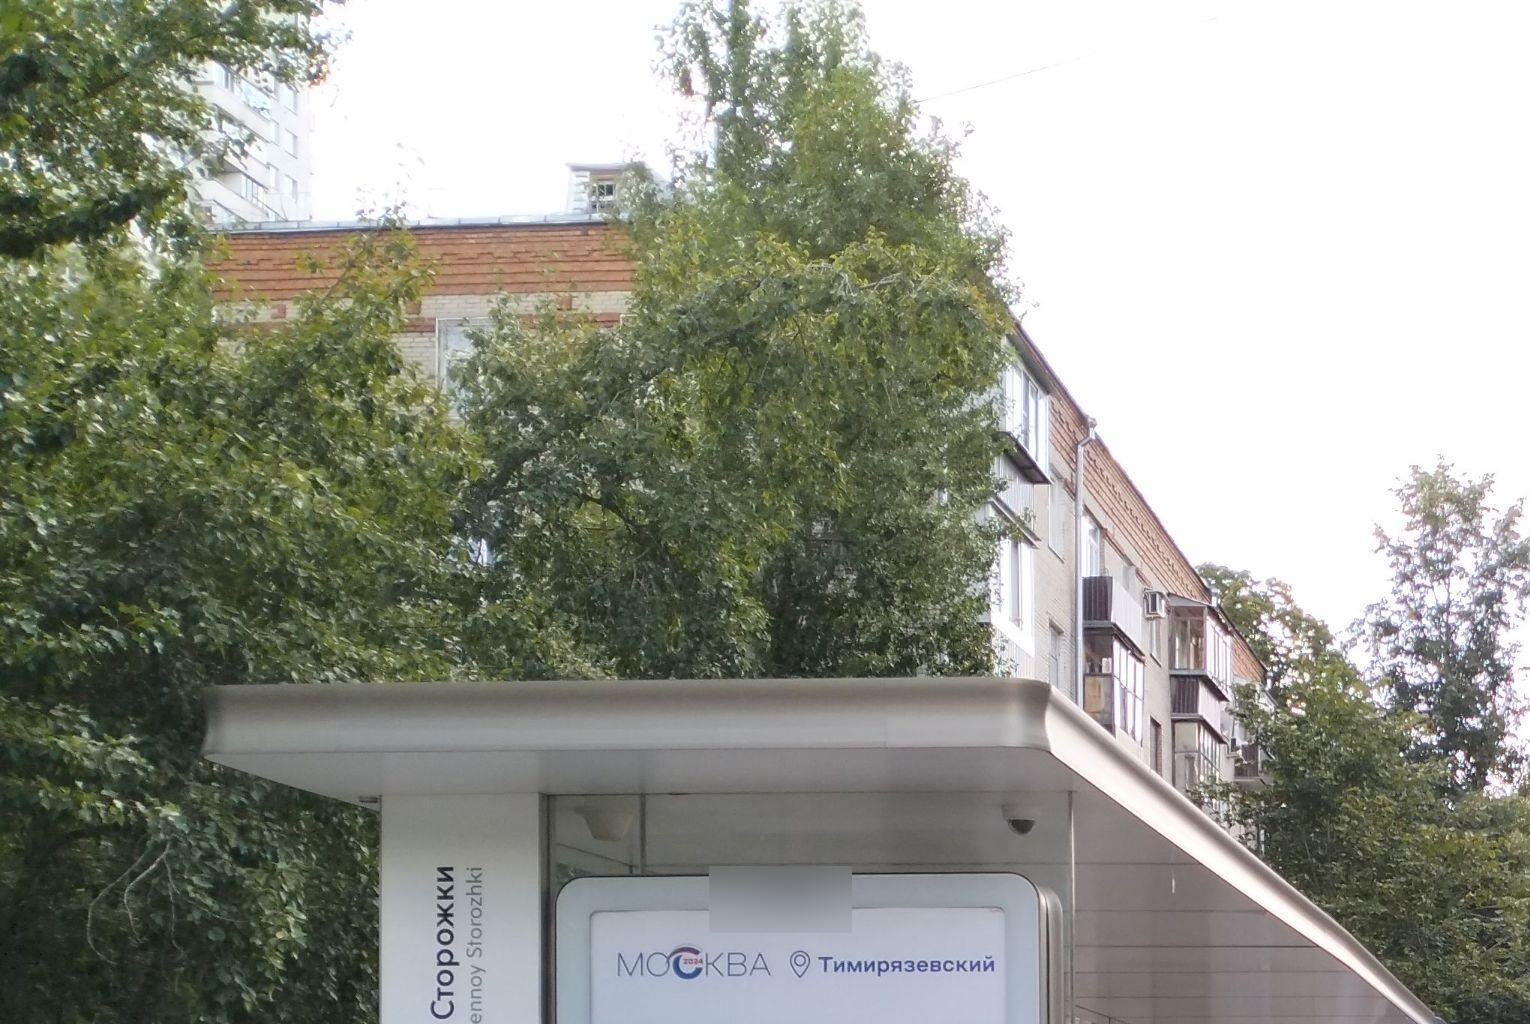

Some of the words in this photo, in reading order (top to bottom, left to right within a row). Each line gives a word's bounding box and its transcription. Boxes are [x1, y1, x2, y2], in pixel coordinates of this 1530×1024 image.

[430, 866, 460, 1020] Сторожки
[465, 867, 482, 958] Storozhki
[617, 945, 771, 980] МОСКВА
[818, 955, 995, 977] Тимирязевский
